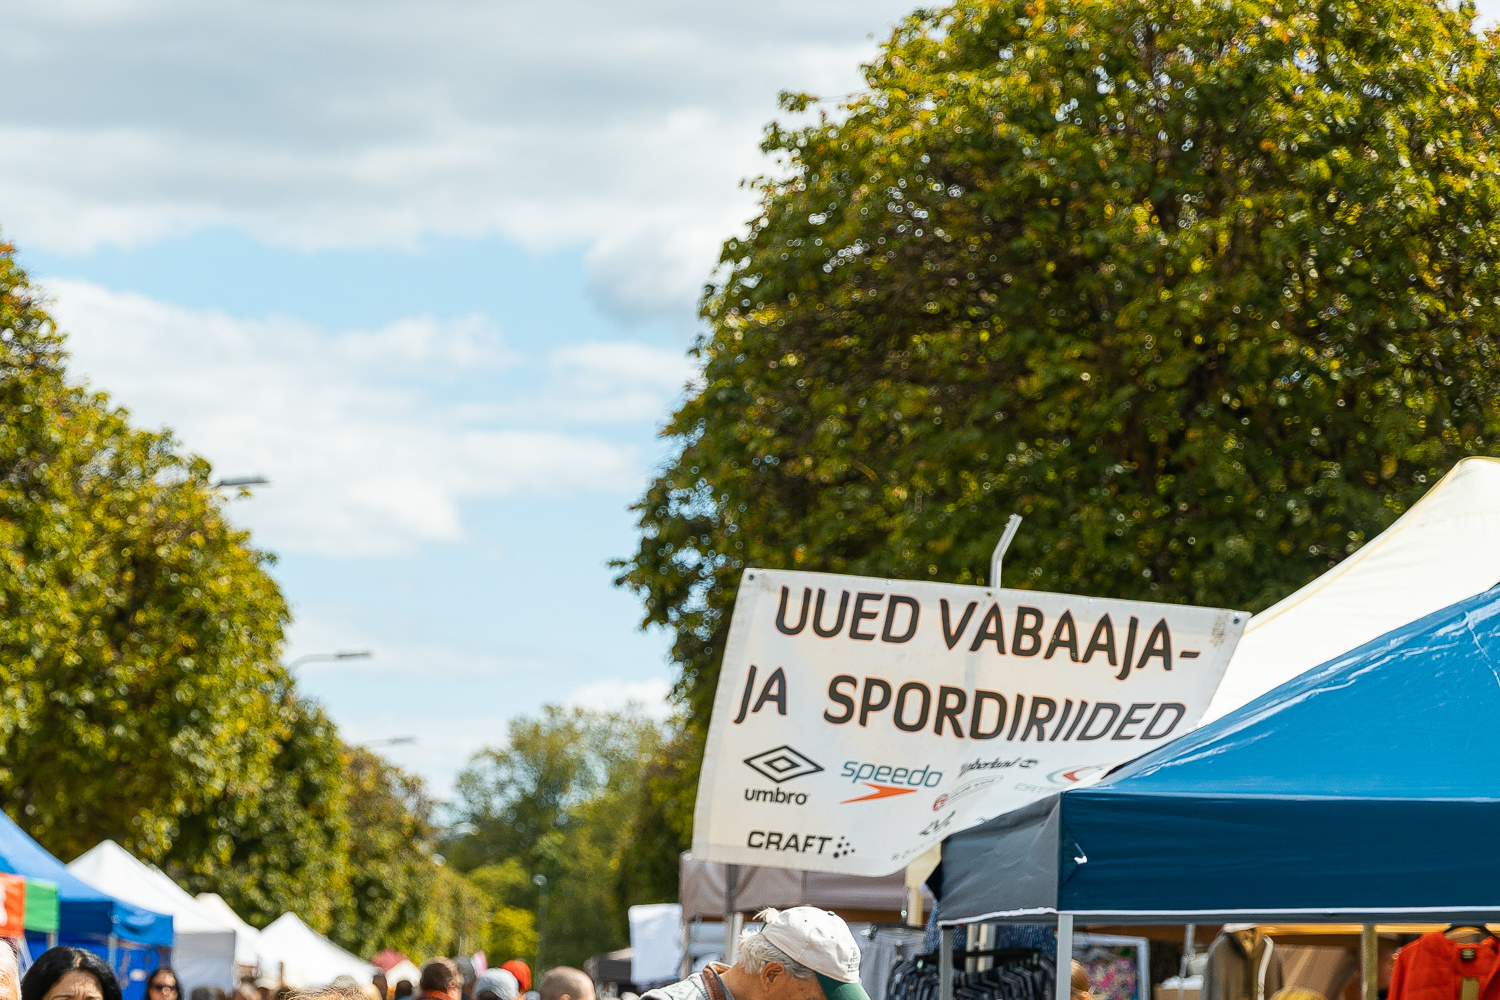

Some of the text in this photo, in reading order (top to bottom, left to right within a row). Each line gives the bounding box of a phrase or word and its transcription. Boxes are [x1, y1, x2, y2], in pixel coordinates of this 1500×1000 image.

[775, 585, 1201, 681] UUED VABAAJA-
[733, 665, 1187, 742] JA SPORDIRIIDED
[840, 760, 943, 788] speedo
[744, 787, 808, 805] umbro
[747, 830, 832, 854] CRAFT
